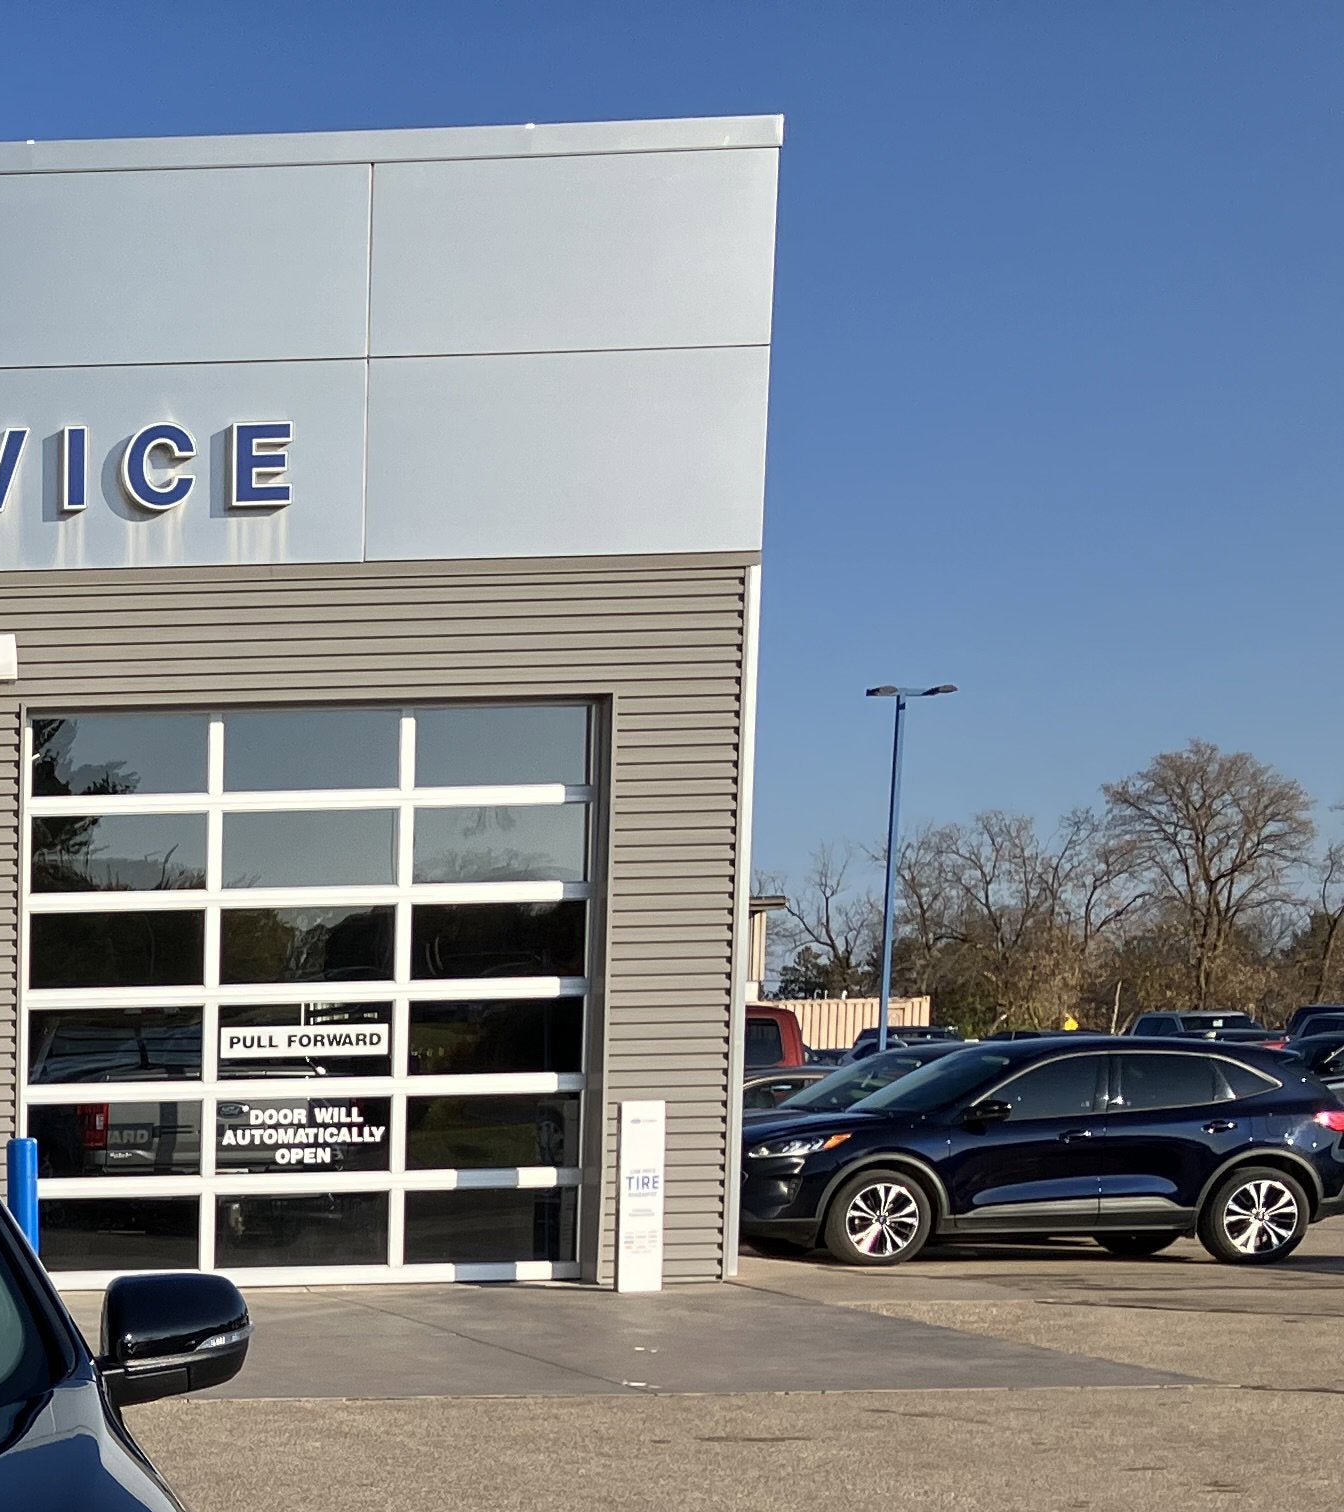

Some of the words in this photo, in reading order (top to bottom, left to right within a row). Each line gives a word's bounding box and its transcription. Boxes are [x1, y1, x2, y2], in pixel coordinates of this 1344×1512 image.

[229, 1034, 279, 1049] PULL
[287, 1032, 382, 1048] FORWARD
[249, 1108, 307, 1126] DOOR
[314, 1107, 364, 1124] WILL
[221, 1126, 386, 1146] AUTOMATICALLY
[274, 1147, 332, 1165] OPEN
[625, 1174, 660, 1191] TIRE
